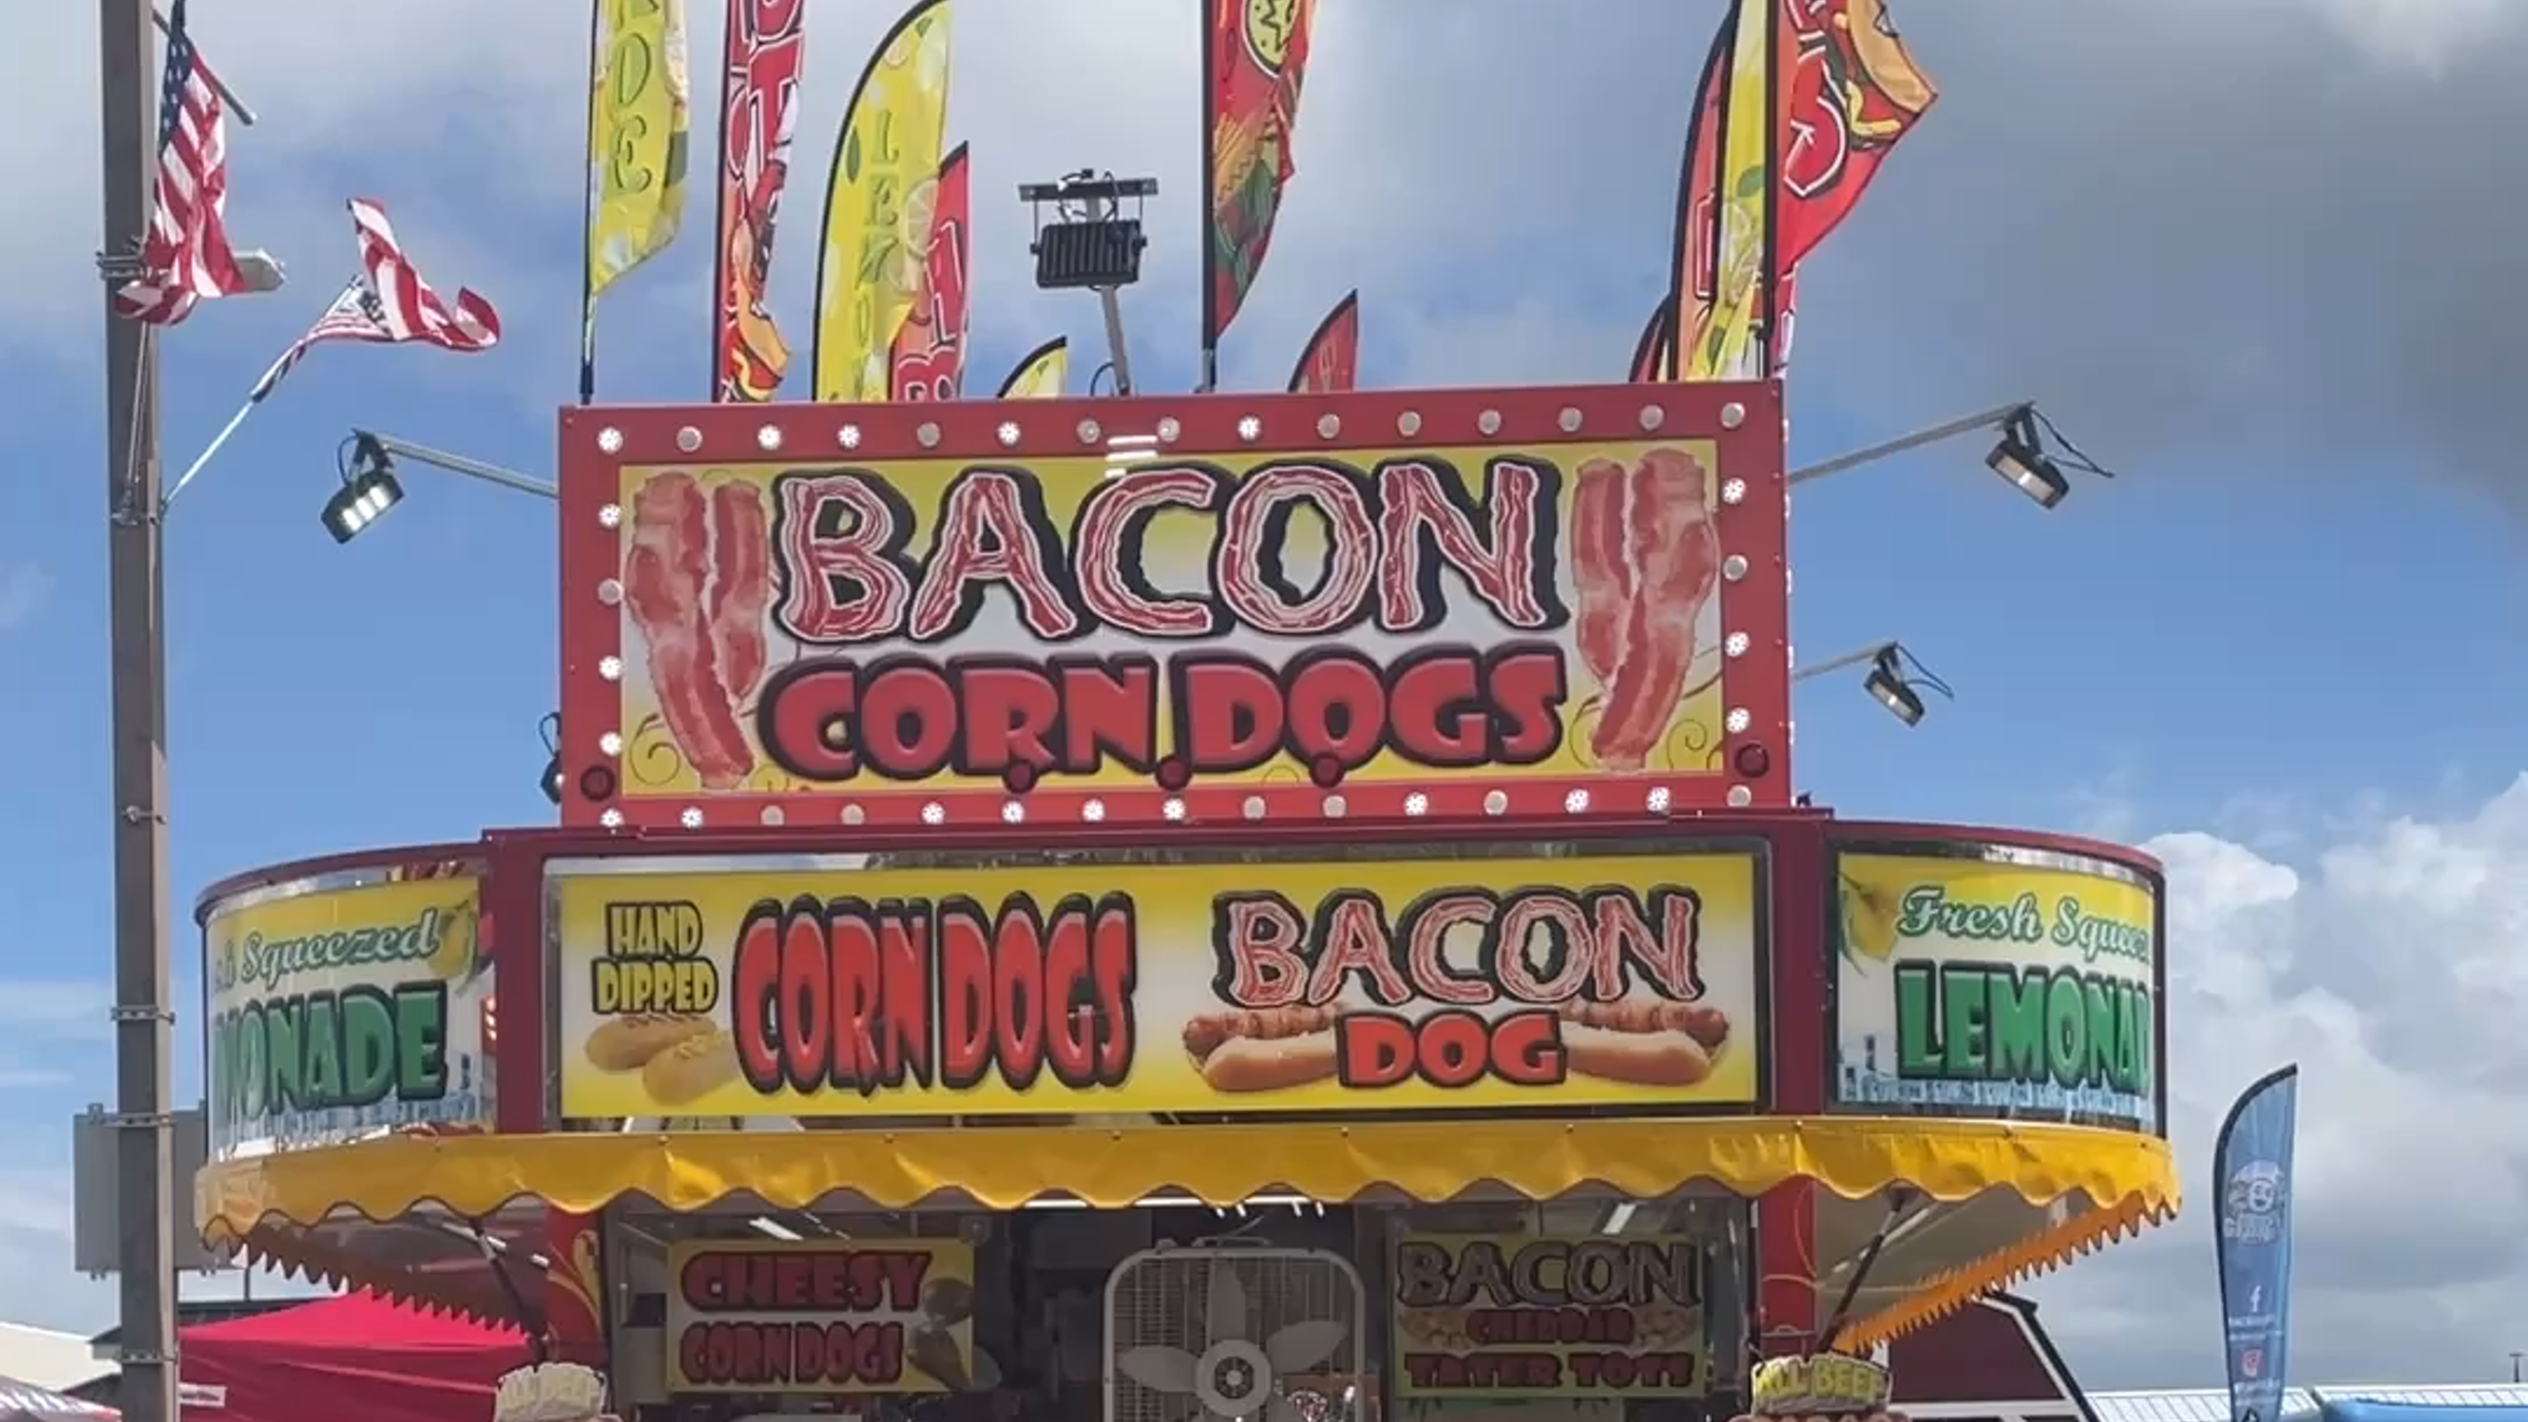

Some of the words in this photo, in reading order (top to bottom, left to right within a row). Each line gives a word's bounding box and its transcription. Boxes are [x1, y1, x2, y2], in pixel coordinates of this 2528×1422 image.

[772, 455, 1570, 643] BACON
[757, 652, 1158, 781] CORN
[1169, 640, 1567, 773] DOGS
[605, 901, 703, 959] HAND
[1211, 884, 1705, 1007] BACON
[1897, 884, 2042, 942] Fresh
[241, 907, 440, 992] Squeezed
[591, 954, 718, 1014] DIPPED
[732, 893, 934, 1097] CORN
[937, 890, 1137, 1089] DOGS
[1333, 1008, 1567, 1089] DOG
[681, 1250, 933, 1312] CHEESY
[1397, 1241, 1701, 1307] BACON
[680, 1321, 792, 1385] CORN
[795, 1321, 904, 1386] DOGS
[1404, 1352, 1563, 1389] TATER
[1568, 1351, 1695, 1390] TOTS
